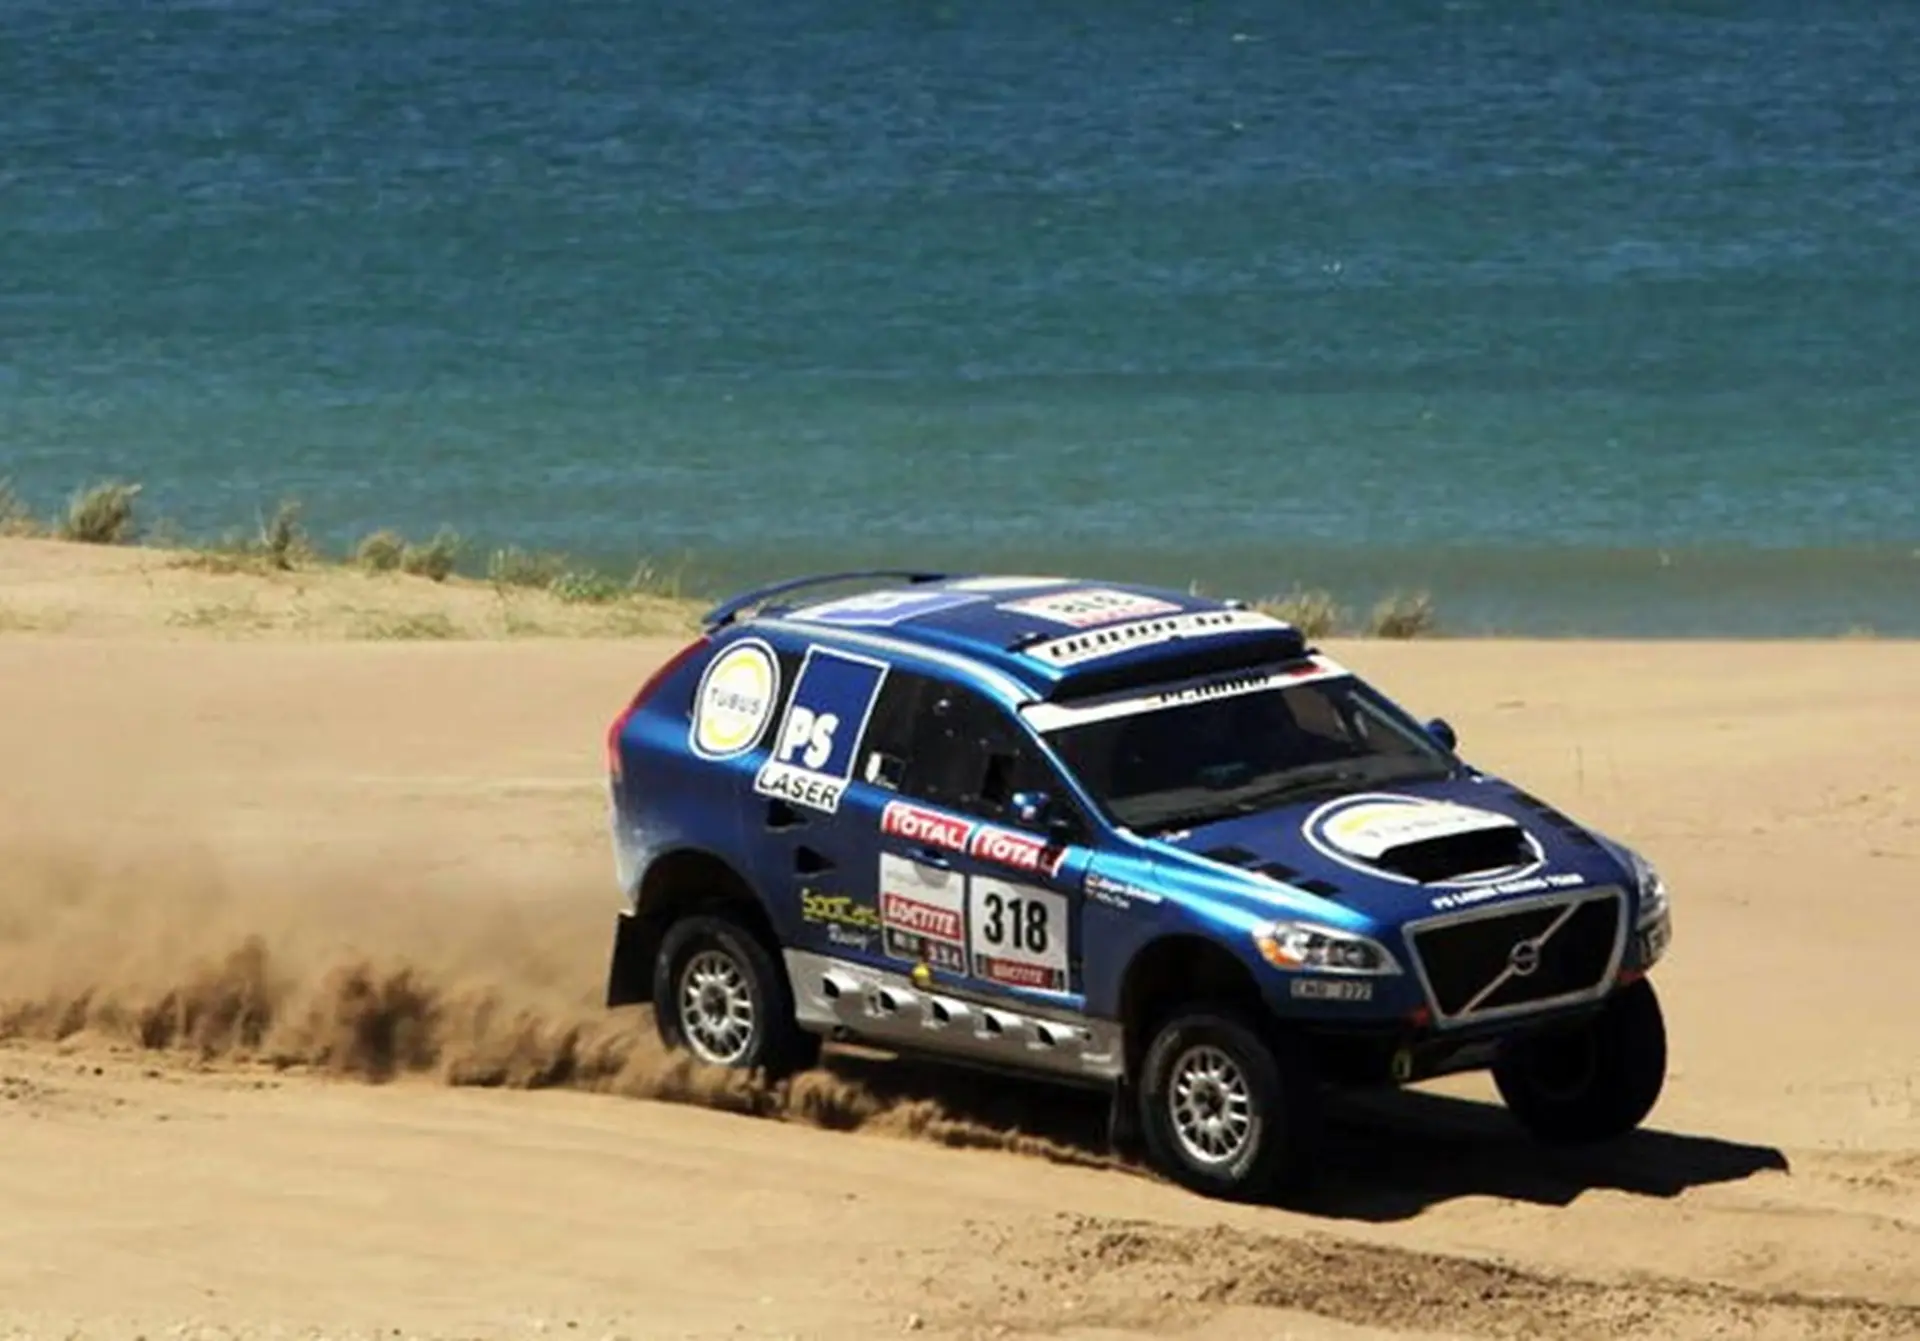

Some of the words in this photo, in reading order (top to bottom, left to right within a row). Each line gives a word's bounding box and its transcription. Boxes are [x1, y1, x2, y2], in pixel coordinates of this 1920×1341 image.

[710, 686, 762, 716] TUBUS
[779, 705, 840, 769] PS
[758, 769, 839, 808] LASER
[890, 807, 961, 848] TOTAL
[887, 897, 957, 936] LOCTITE
[983, 892, 1048, 955] 318
